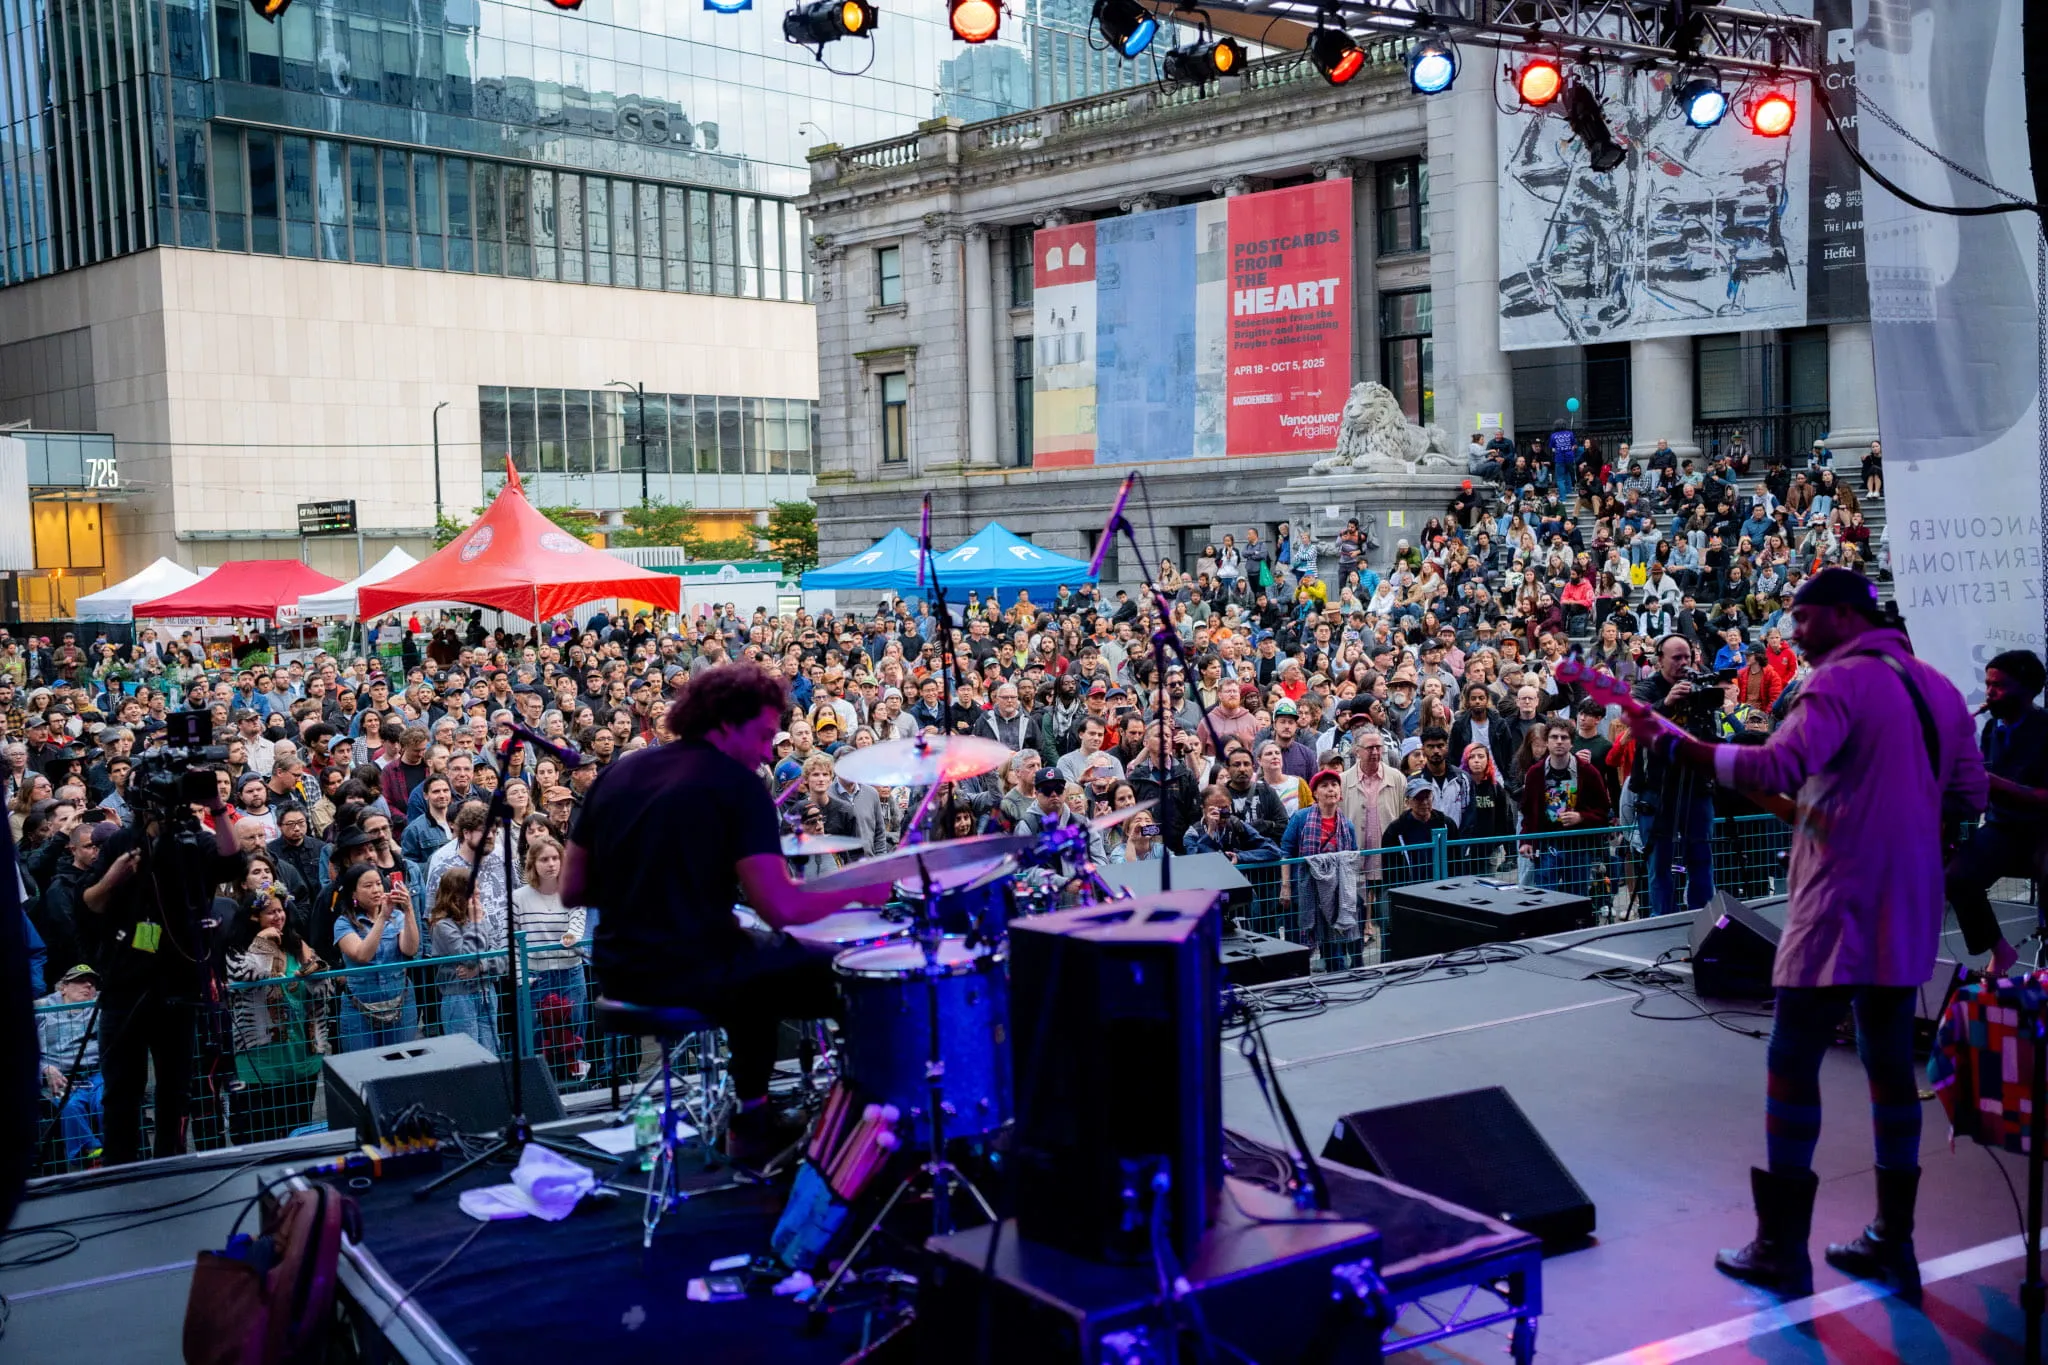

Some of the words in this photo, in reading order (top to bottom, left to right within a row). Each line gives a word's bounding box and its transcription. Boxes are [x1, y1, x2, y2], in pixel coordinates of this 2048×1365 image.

[1824, 223, 1840, 232] THE
[1234, 229, 1340, 256] POSTCARDS
[1824, 245, 1856, 259] Heffel
[1234, 254, 1283, 272] FROM
[1234, 272, 1267, 288] THE
[1234, 277, 1340, 316] HEART
[1234, 315, 1287, 328] Selections
[1290, 312, 1313, 322] from
[1316, 309, 1333, 319] the
[1234, 328, 1272, 340] Brigitte
[1274, 324, 1293, 335] and
[1270, 333, 1323, 346] Collection
[1234, 365, 1252, 376] APR
[1253, 364, 1263, 374] 18
[1271, 361, 1291, 372] OCT
[1302, 358, 1325, 370] 2025
[1280, 412, 1340, 426] Vancouver
[1292, 424, 1340, 439] Artgallery
[86, 458, 118, 487] 725
